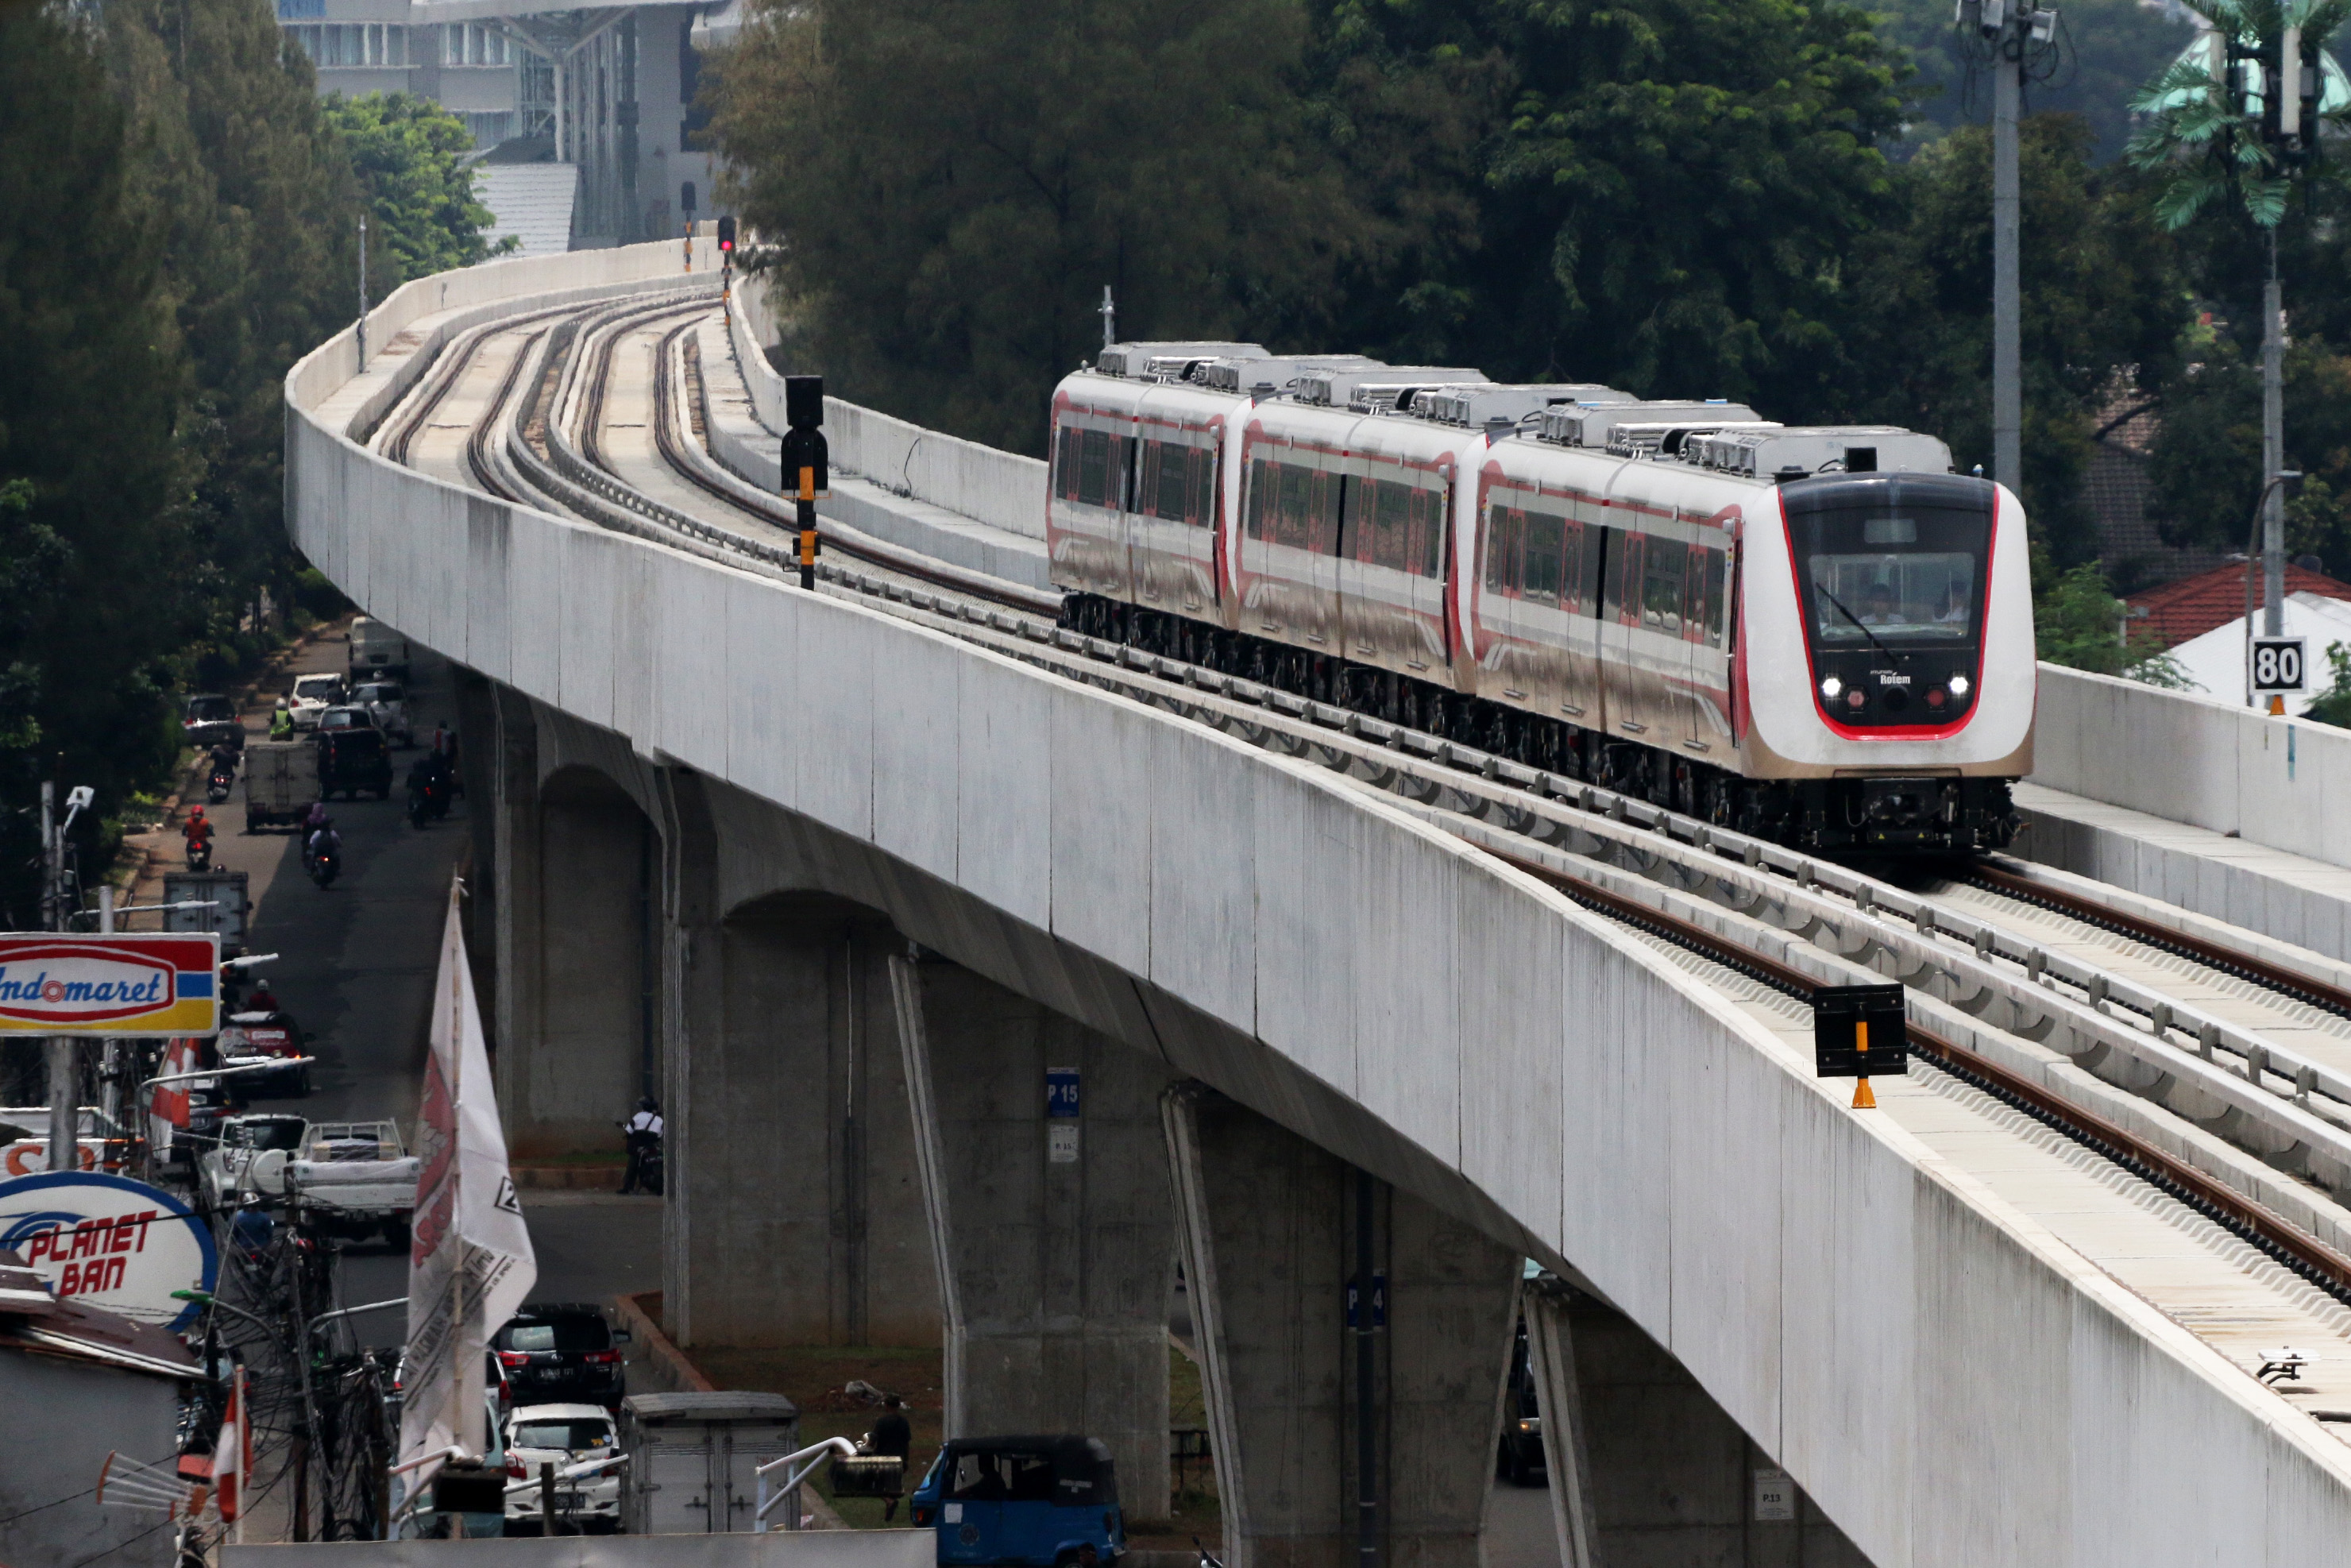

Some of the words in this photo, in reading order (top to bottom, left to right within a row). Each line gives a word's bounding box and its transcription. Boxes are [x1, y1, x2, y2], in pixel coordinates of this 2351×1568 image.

[1880, 672, 1911, 685] Rotem
[2257, 647, 2300, 684] 80
[1048, 1084, 1056, 1102] P
[1061, 1084, 1079, 1103] 15
[29, 1210, 157, 1268] PLANET
[59, 1256, 127, 1297] BAN
